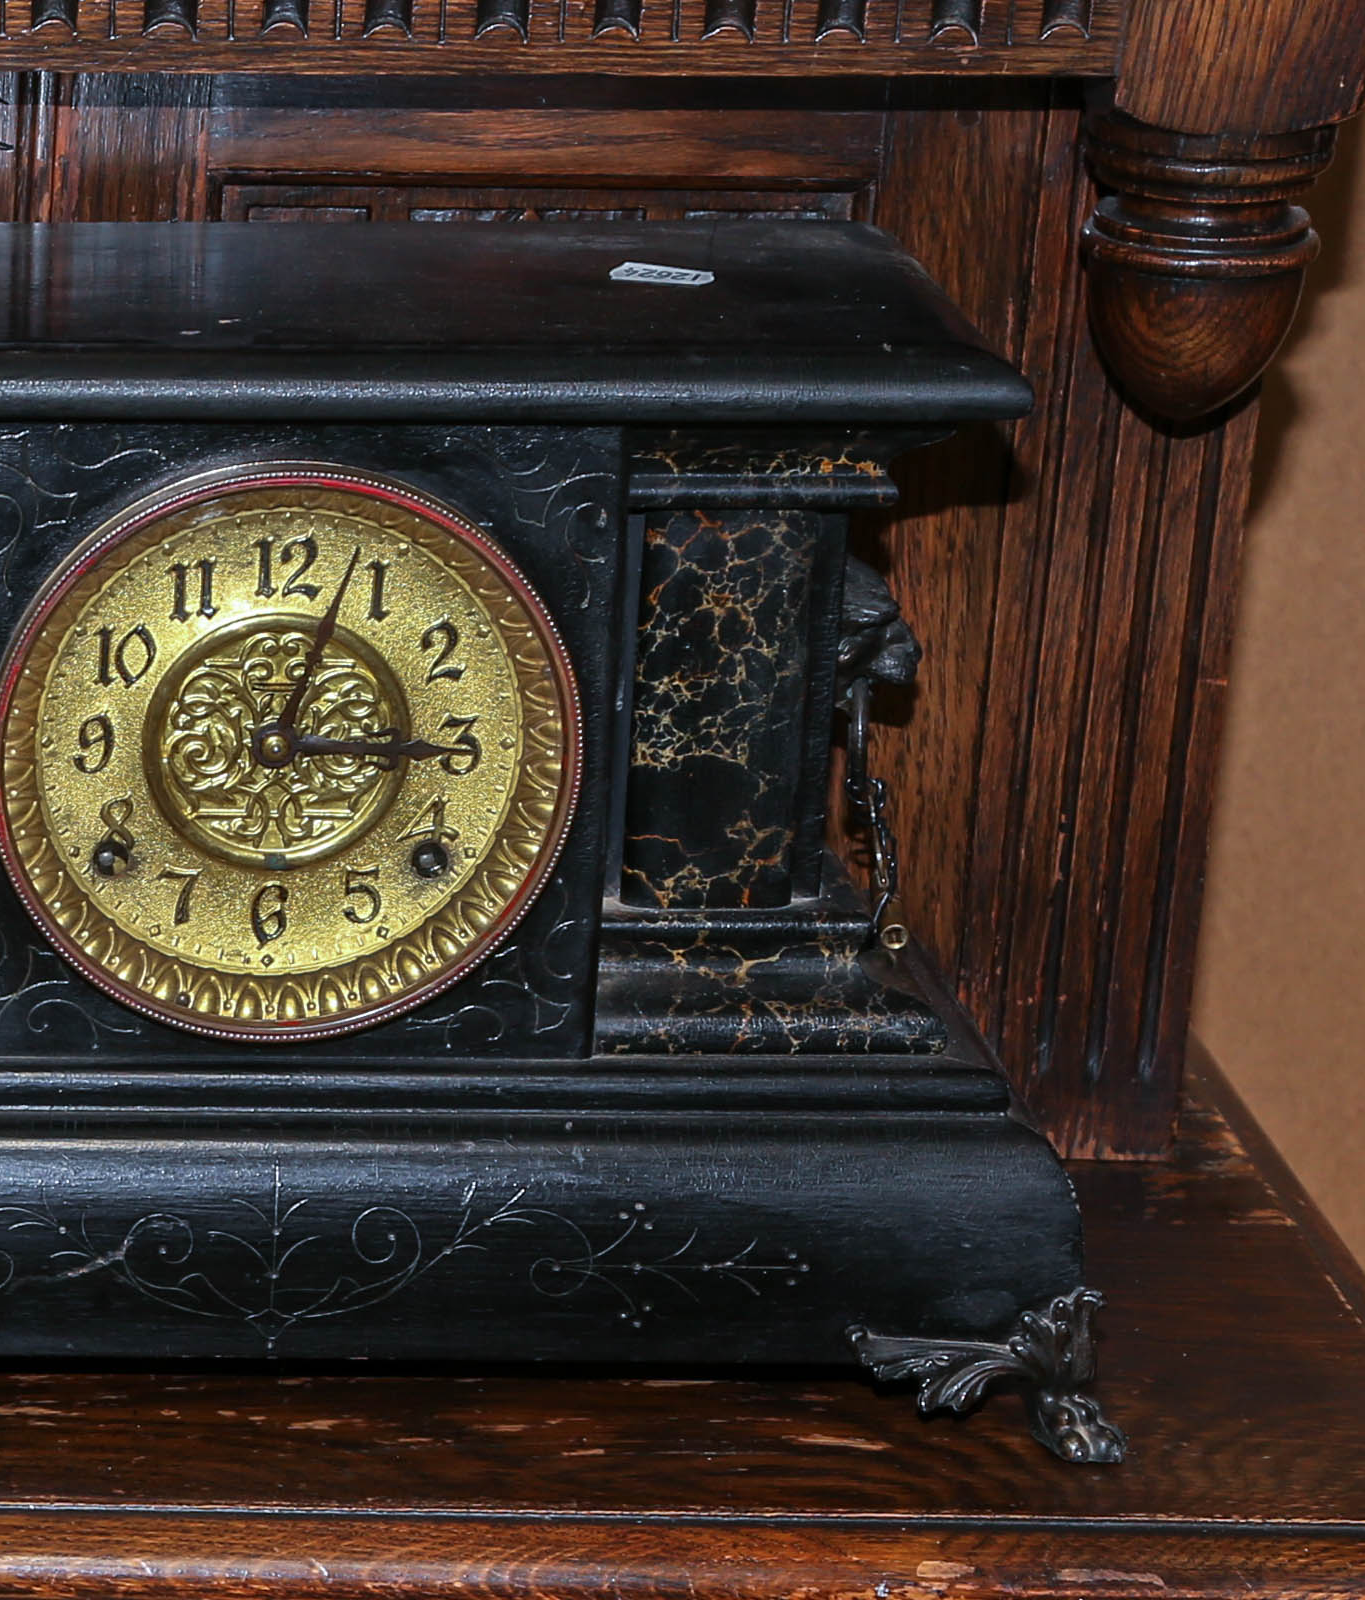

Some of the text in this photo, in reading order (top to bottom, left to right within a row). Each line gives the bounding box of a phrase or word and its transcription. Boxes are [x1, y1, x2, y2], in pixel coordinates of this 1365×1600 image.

[170, 558, 219, 622] 11
[253, 529, 322, 597] 12
[368, 560, 391, 621] 1
[94, 624, 156, 689] 10
[422, 621, 464, 686] 2
[73, 714, 115, 774] 9
[437, 713, 482, 776] 3
[396, 793, 459, 842] 4
[155, 864, 204, 926] 7
[251, 883, 288, 949] 6
[344, 866, 382, 923] 5
